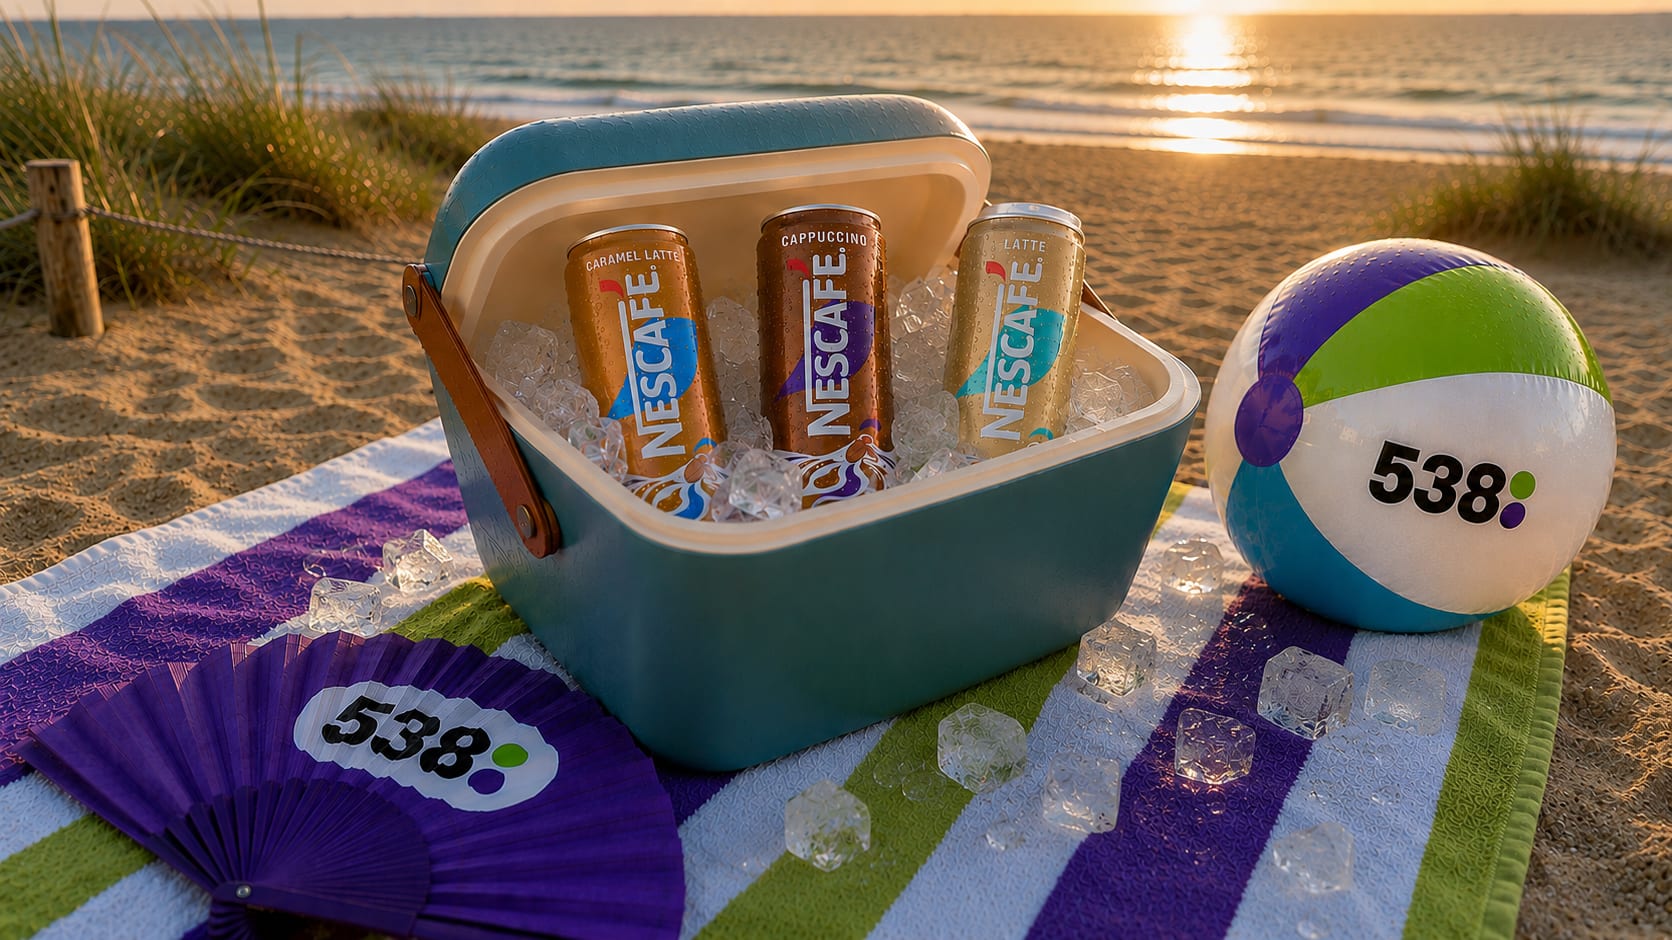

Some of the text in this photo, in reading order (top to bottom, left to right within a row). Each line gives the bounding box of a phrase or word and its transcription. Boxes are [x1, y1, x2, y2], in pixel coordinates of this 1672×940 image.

[781, 231, 867, 247] CAPPUCCINO
[1004, 239, 1046, 252] LATTE
[586, 249, 681, 272] CARAMEL LATTE
